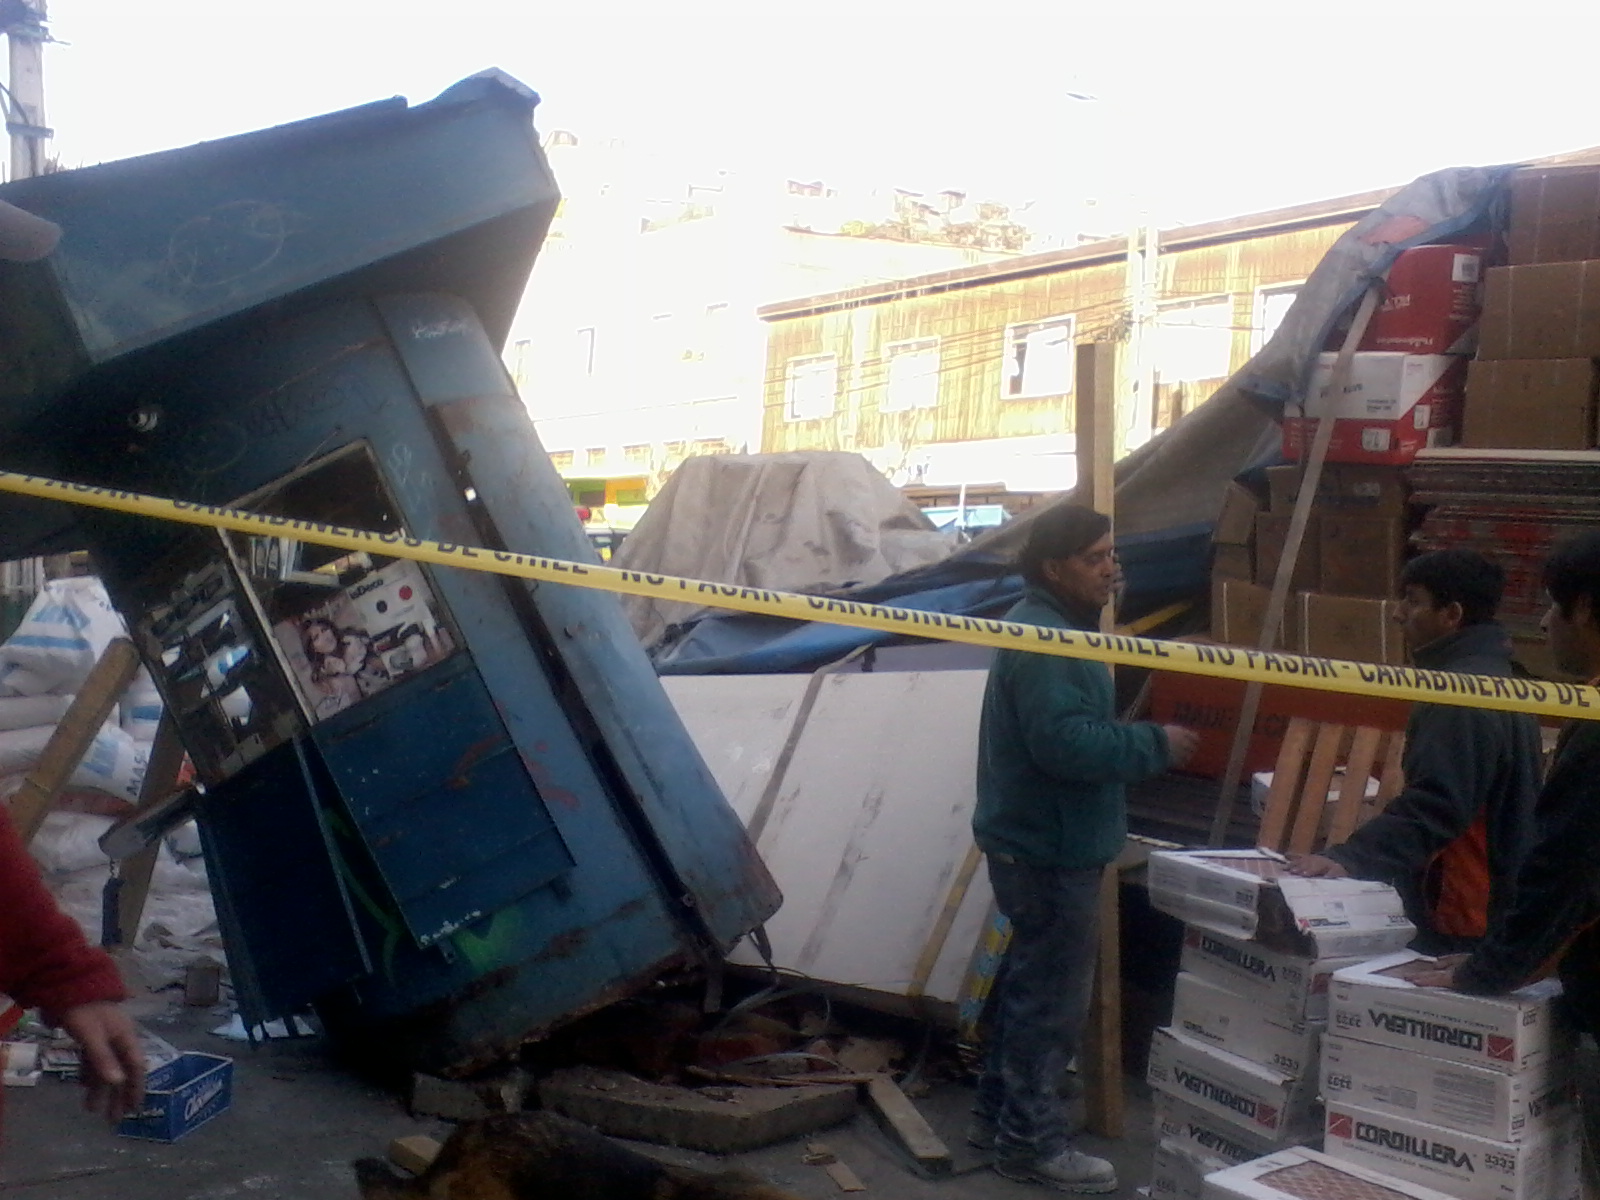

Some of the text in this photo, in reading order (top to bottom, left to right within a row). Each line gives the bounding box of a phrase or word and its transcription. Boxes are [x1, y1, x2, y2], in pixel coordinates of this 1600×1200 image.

[1245, 650, 1338, 678] PASAR
[1355, 660, 1547, 702] CARABINEROS
[1550, 681, 1590, 707] DE
[1367, 1007, 1483, 1052] CORDILLERA
[1355, 1120, 1475, 1173] CORDILLERA
[1484, 1152, 1516, 1171] 3333
